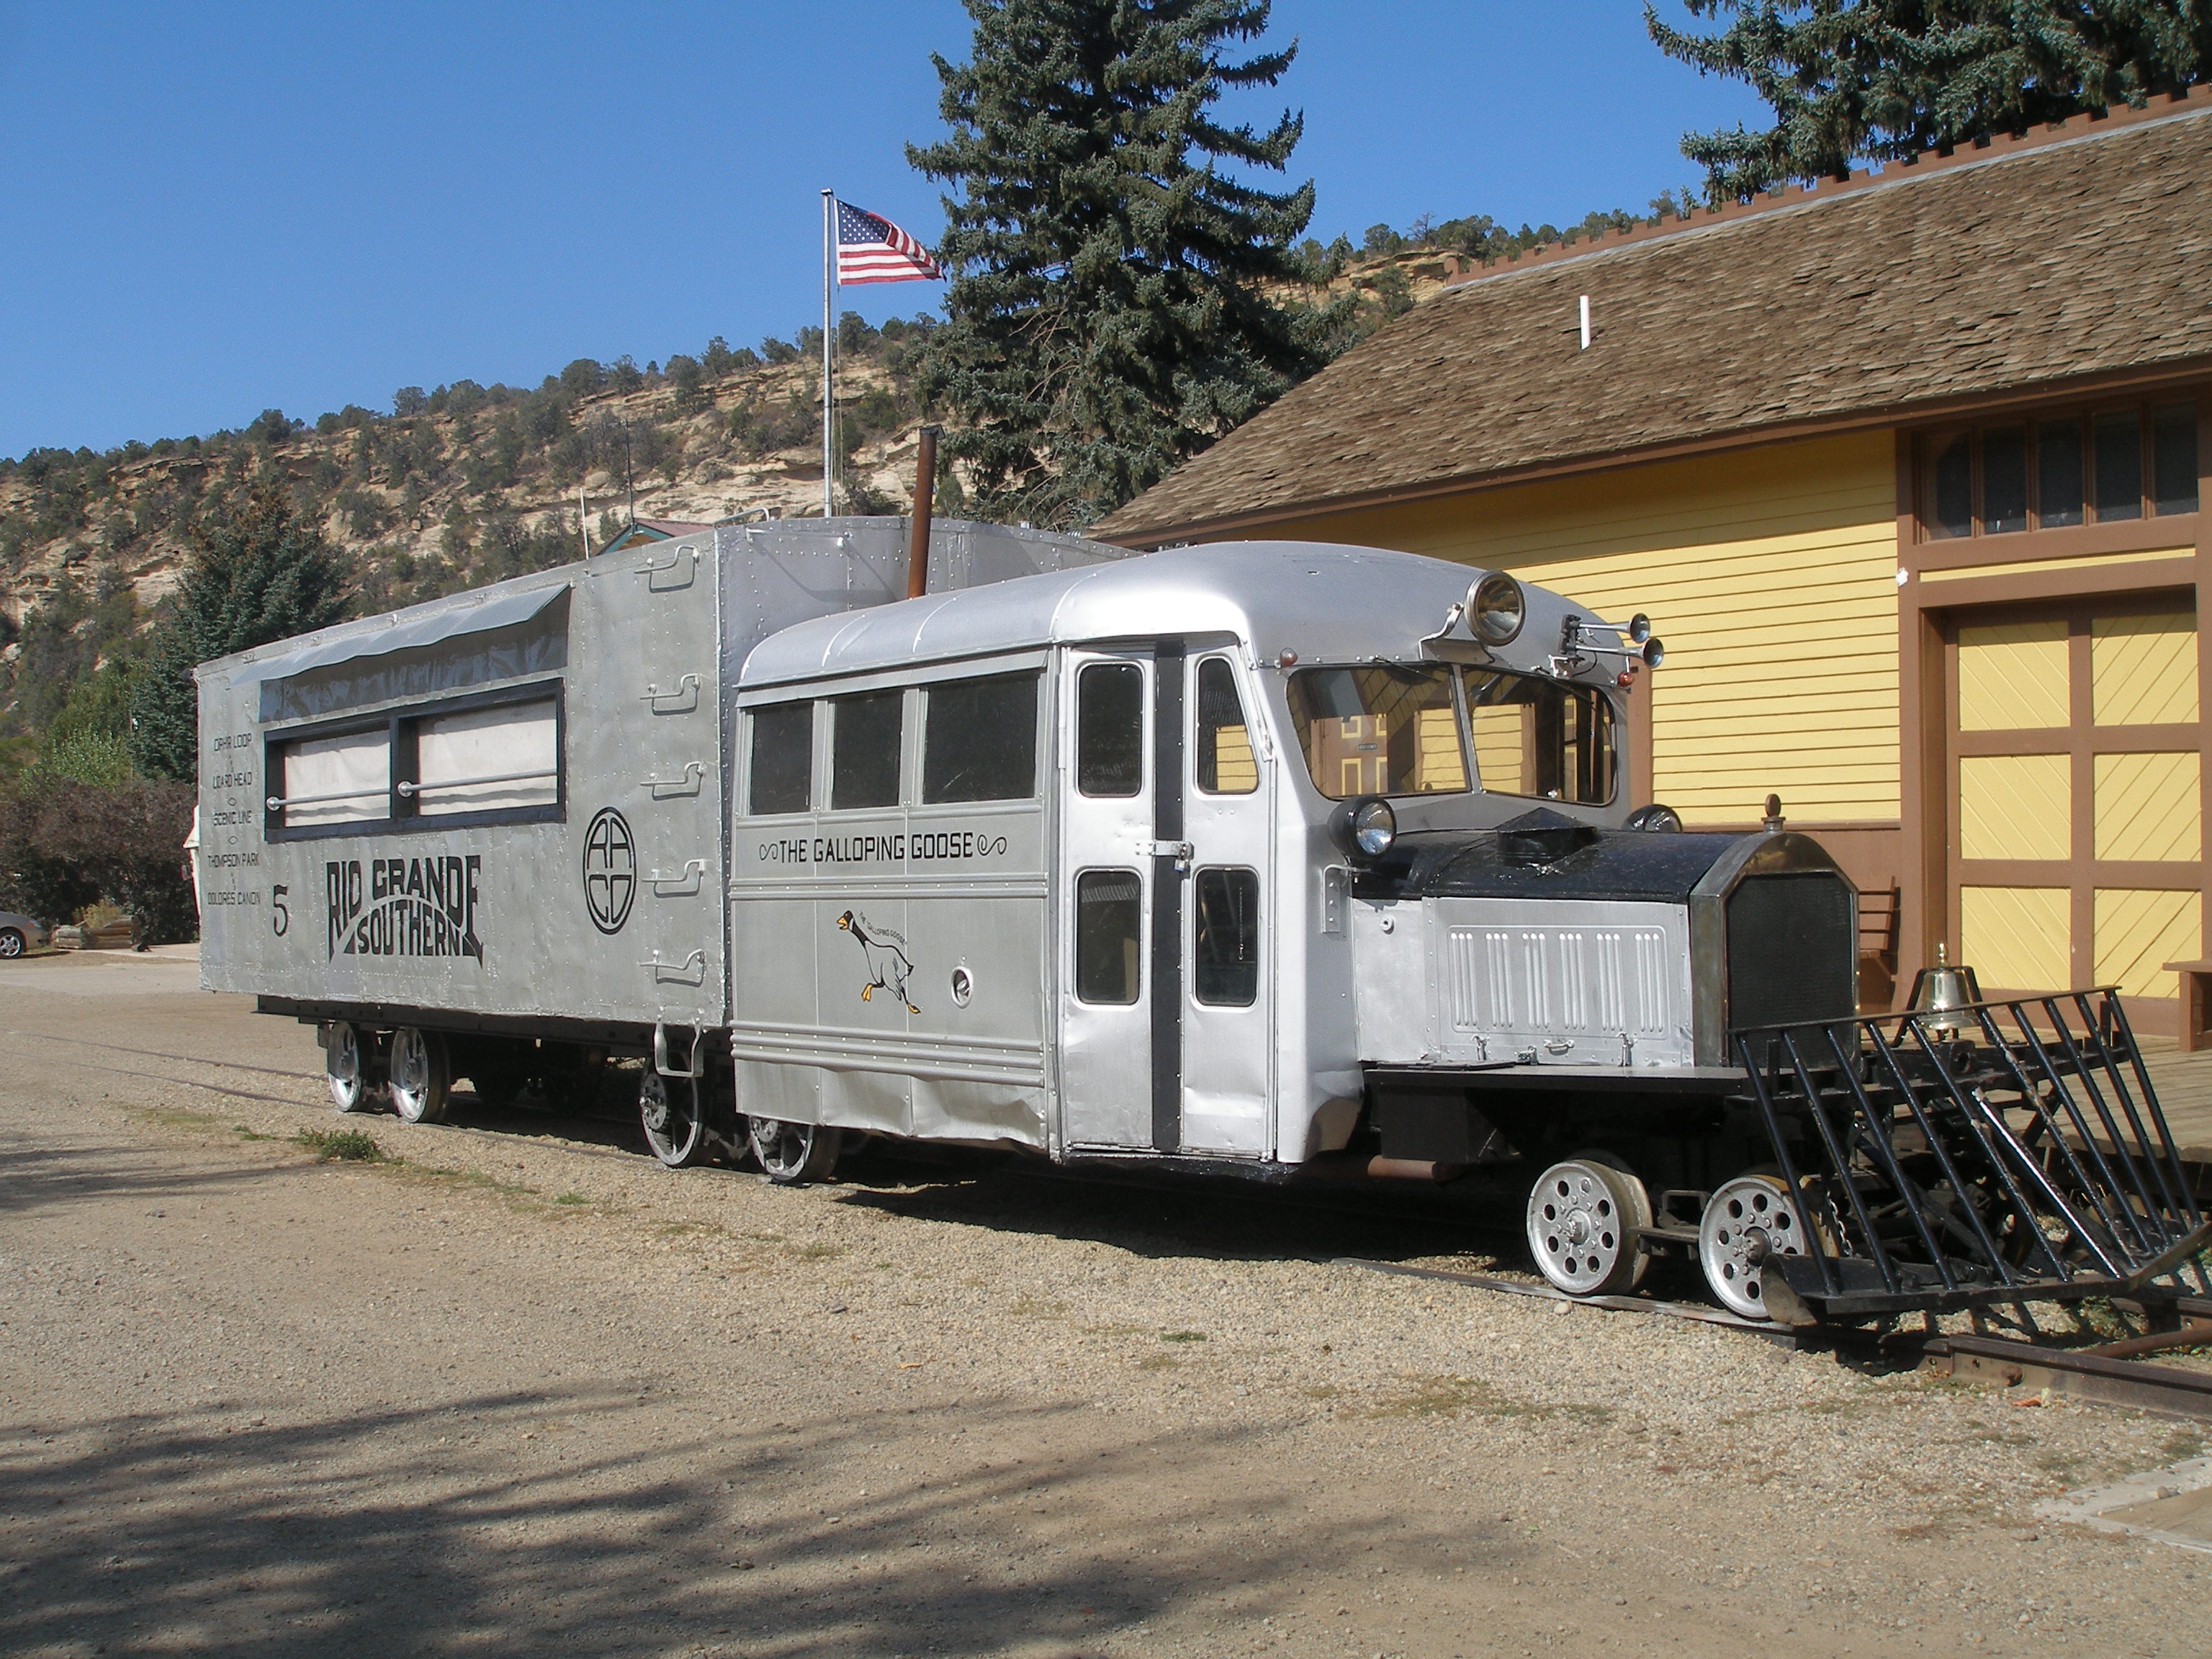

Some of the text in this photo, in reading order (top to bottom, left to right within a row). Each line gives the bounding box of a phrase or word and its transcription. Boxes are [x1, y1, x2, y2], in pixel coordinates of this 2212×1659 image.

[233, 733, 252, 748] LOOP
[234, 772, 253, 786] HEAD
[238, 810, 252, 824] LINE
[779, 832, 973, 863] THE GALLOPING GOOSE
[207, 853, 260, 868] THOMPSON PARK
[207, 891, 236, 906] DOLORES
[274, 885, 288, 937] 5
[326, 855, 483, 969] RIO GRANDE
[357, 899, 461, 956] SOUTHERN
